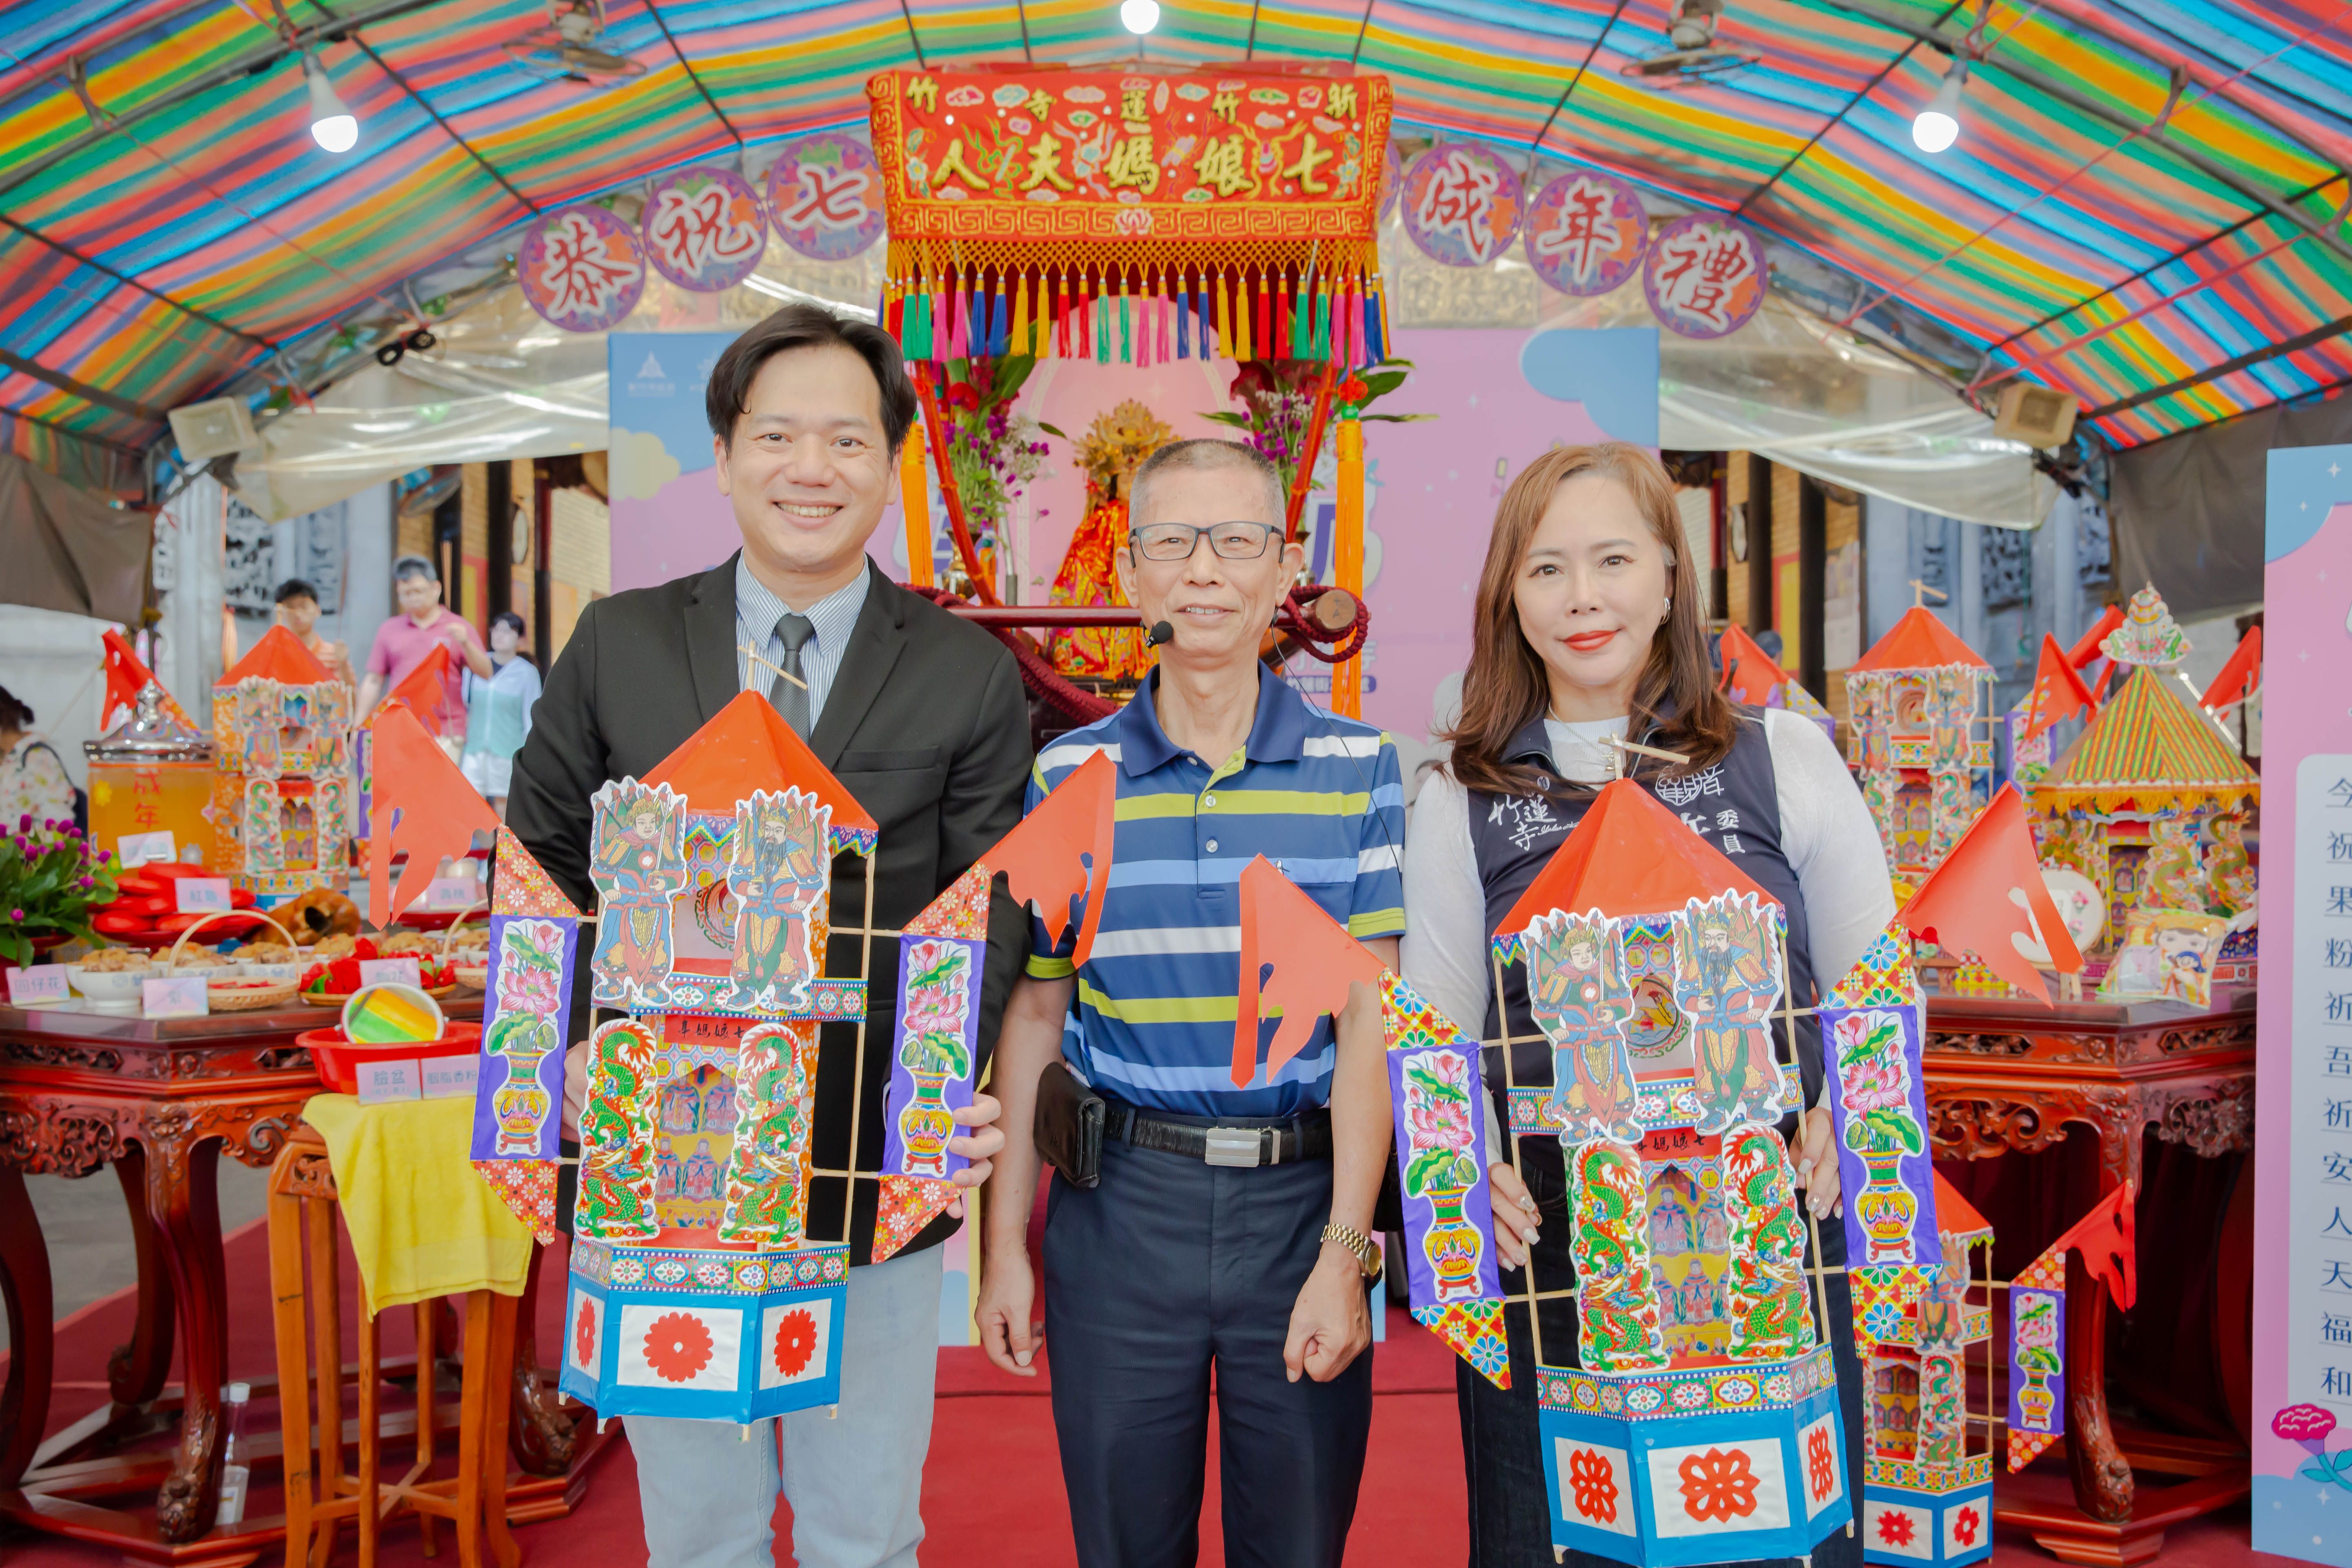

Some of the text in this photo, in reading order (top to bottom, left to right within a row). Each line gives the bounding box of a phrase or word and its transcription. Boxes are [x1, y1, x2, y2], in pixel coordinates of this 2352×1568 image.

[1716, 809, 1746, 855] 委員
[2327, 831, 2352, 860] 祝
[2325, 938, 2352, 968] 粉
[2324, 991, 2352, 1020] 祈
[2325, 1046, 2352, 1075] 吾
[2323, 1098, 2352, 1128] 祈
[2323, 1152, 2352, 1183] 安
[2321, 1311, 2352, 1343] 福
[2321, 1366, 2352, 1397] 和
